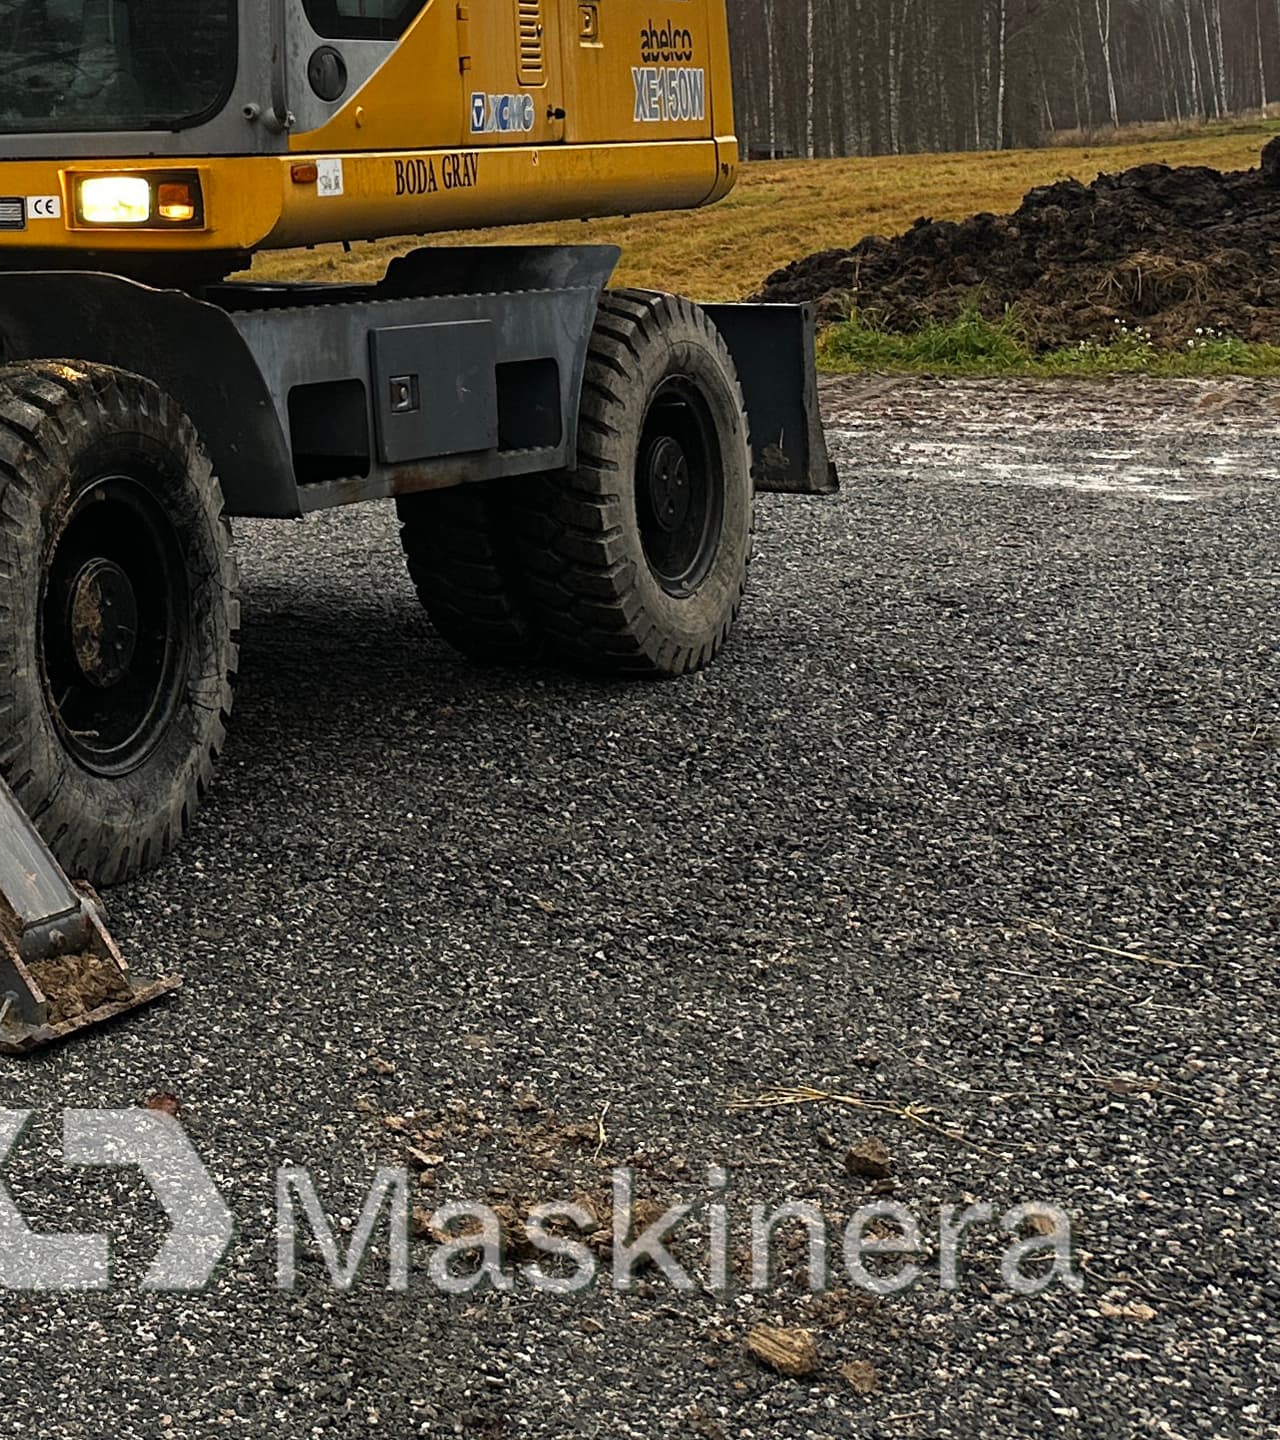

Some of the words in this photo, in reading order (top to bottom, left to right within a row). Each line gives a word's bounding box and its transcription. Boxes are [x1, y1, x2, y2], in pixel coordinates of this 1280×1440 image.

[641, 19, 693, 62] abelco
[487, 93, 535, 132] XCMG
[631, 66, 705, 122] XE150W
[394, 158, 438, 196] BODA
